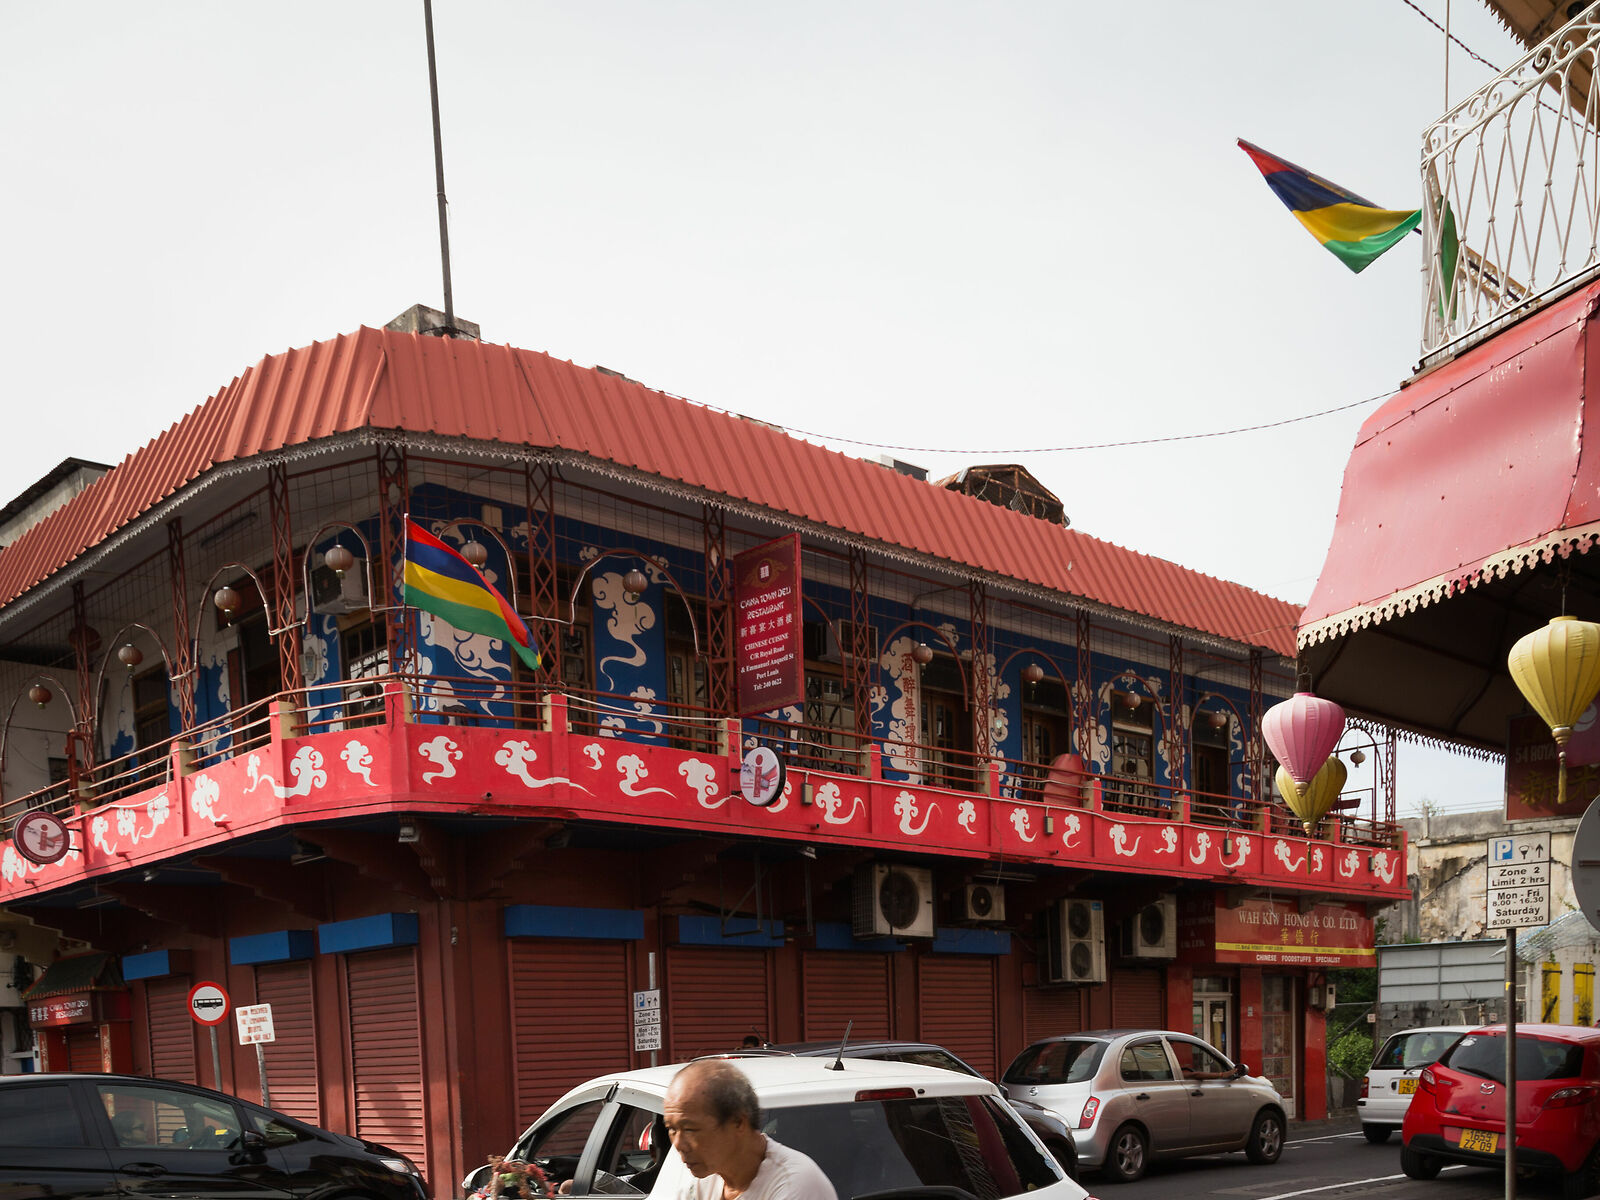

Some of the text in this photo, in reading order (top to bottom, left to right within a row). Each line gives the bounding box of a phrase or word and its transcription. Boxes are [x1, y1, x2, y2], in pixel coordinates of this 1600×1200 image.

[760, 590, 777, 604] TOWN
[777, 586, 791, 598] DELI
[747, 601, 784, 620] RESTAURANT
[744, 632, 789, 651] CHINESE CUISINE
[760, 648, 773, 659] Royal
[773, 645, 785, 654] Road
[746, 660, 770, 672] Emmanuel
[756, 668, 779, 680] Port Louis
[1530, 743, 1556, 762] ROYA
[1496, 841, 1512, 861] P
[1499, 866, 1540, 877] Zone 2
[1492, 876, 1545, 887] Limit 2 hrs
[1497, 892, 1518, 900] Mon
[1527, 889, 1540, 897] Fri
[1519, 896, 1544, 904] 16.30
[1496, 906, 1540, 917] Saturday
[1238, 910, 1358, 930] WAH KIW HONG & CO. LTD.
[1492, 918, 1511, 926] 8.00
[1519, 915, 1544, 923] 12.30
[1256, 954, 1341, 964] CHINESE FOODSTUFFS SPECIALIST
